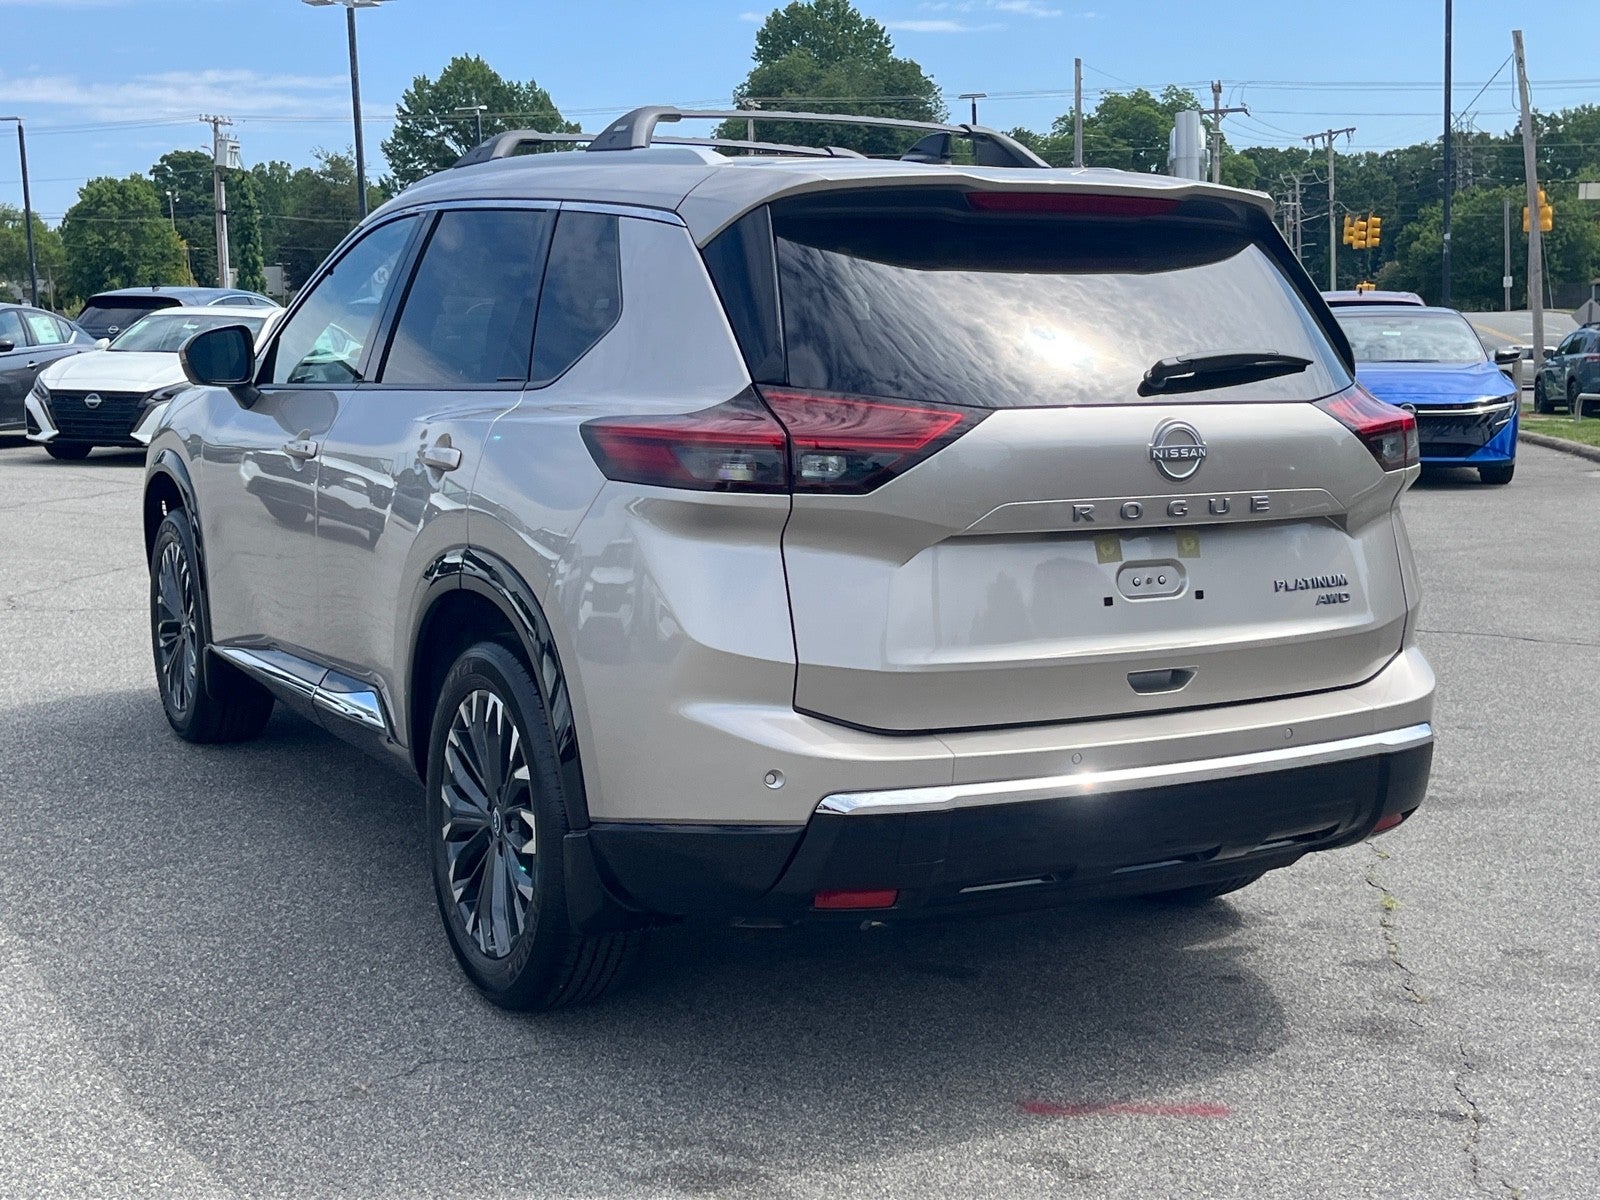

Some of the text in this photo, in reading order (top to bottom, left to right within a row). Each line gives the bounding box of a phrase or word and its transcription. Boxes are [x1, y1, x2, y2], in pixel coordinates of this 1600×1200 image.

[1152, 448, 1206, 458] NISSAN
[1072, 495, 1271, 522] ROGUE
[1273, 574, 1348, 592] PLATINUM
[1315, 592, 1351, 606] AWD
